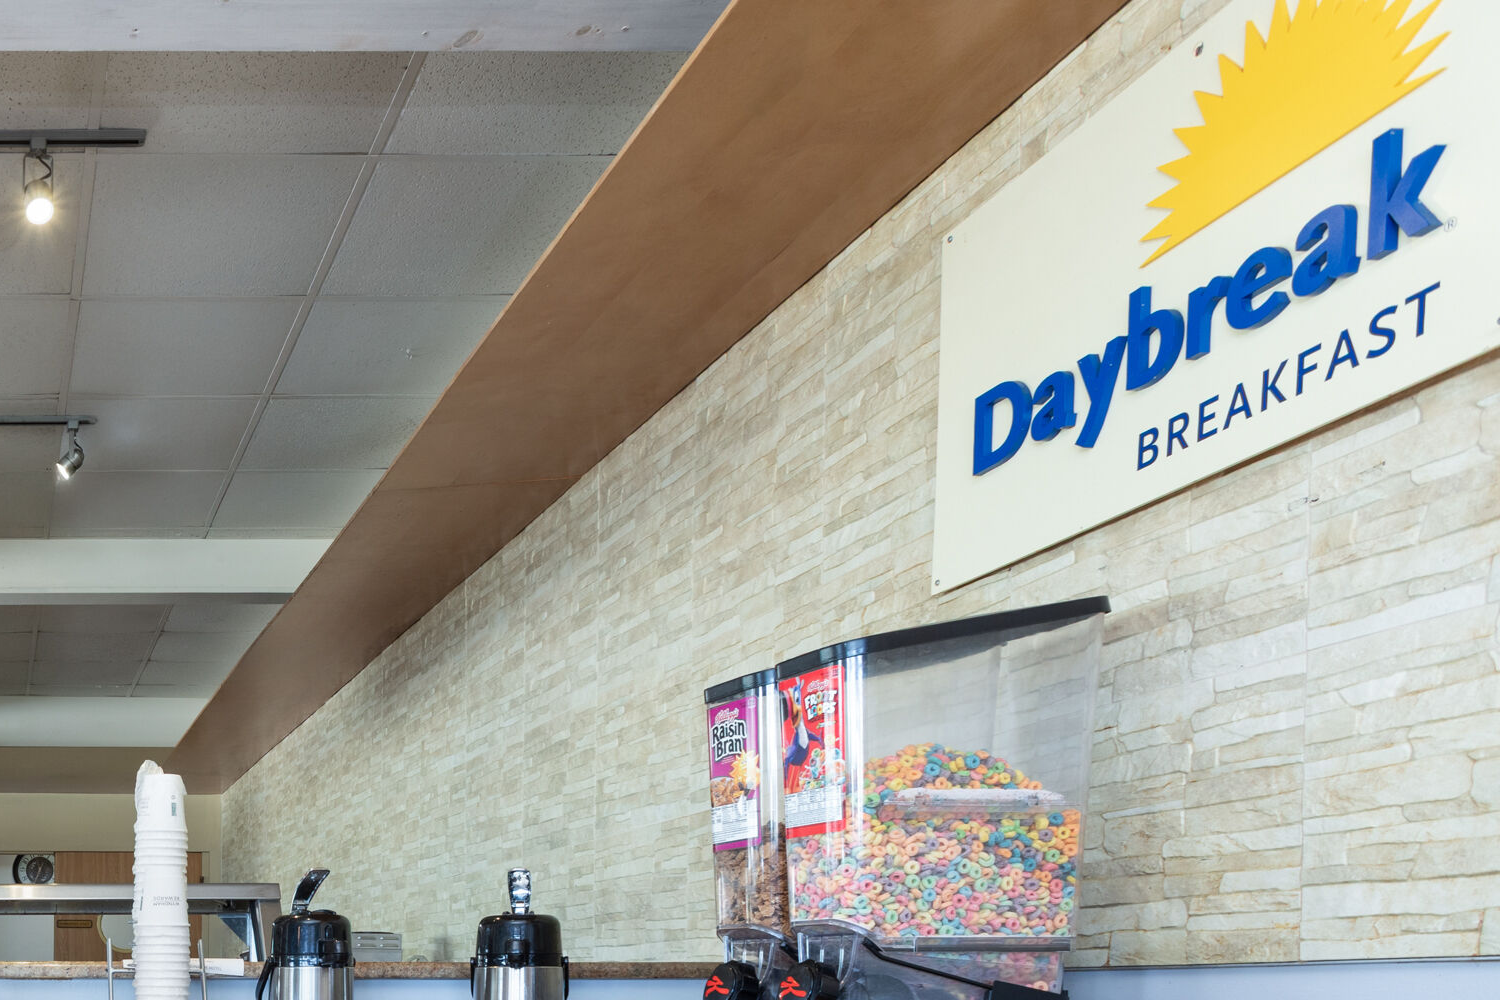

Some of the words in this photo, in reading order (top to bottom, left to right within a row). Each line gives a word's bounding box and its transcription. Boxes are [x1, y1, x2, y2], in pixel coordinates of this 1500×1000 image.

[973, 128, 1447, 476] Daybreak
[1136, 281, 1441, 471] BREAKFAST
[711, 720, 746, 747] Raisin
[715, 738, 743, 760] Bran
